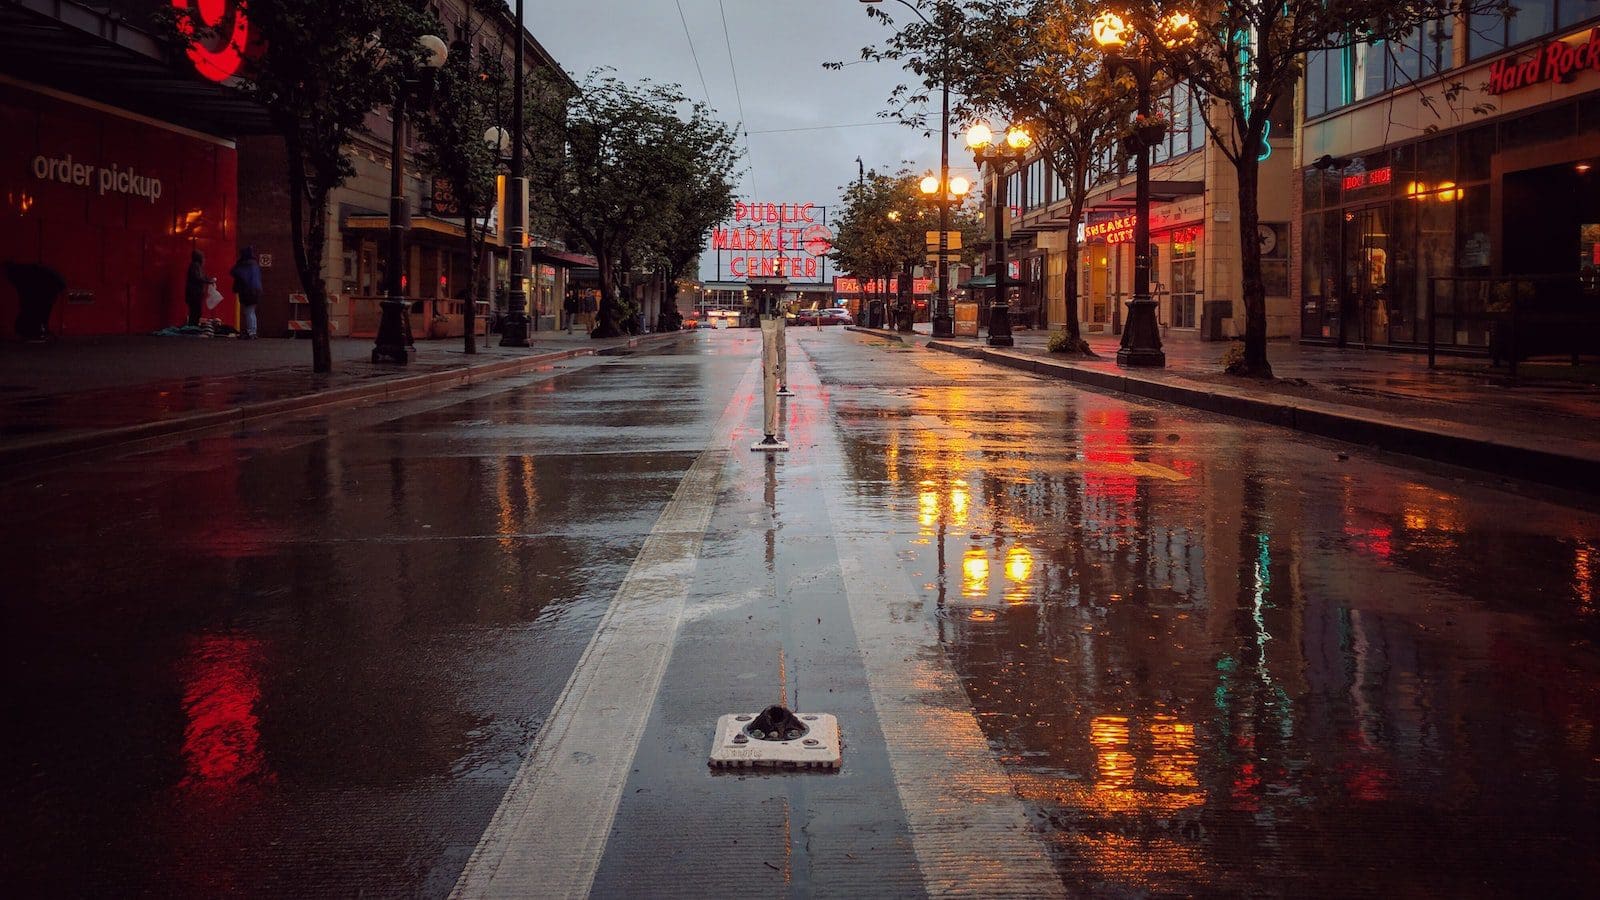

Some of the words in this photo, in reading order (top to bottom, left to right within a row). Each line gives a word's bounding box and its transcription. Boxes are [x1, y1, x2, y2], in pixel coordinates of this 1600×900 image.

[1488, 45, 1543, 95] Hard
[1545, 26, 1600, 84] Rock
[34, 154, 94, 186] order
[100, 163, 161, 204] pickup
[735, 202, 814, 223] PUBLIC
[712, 227, 802, 251] MARKET
[1106, 229, 1133, 243] CITY
[730, 256, 817, 278] CENTER
